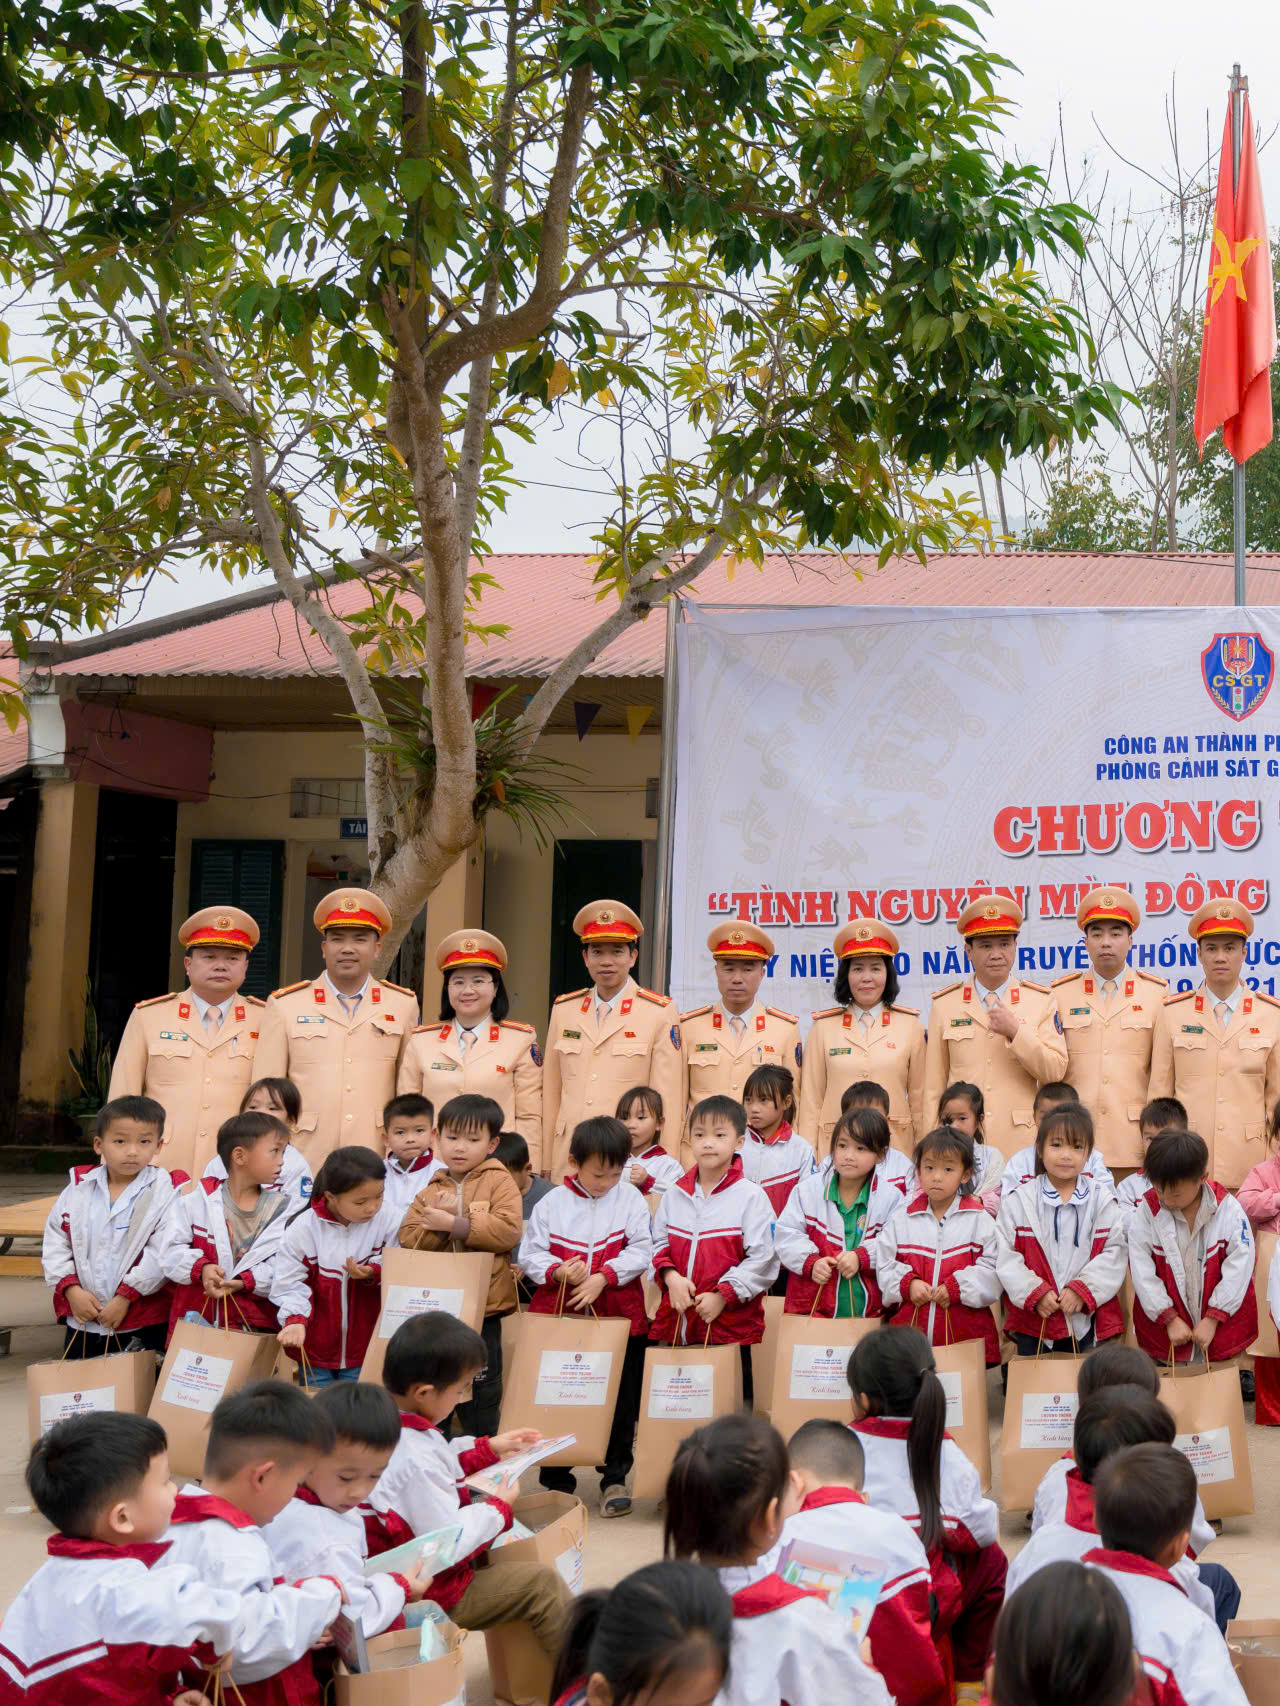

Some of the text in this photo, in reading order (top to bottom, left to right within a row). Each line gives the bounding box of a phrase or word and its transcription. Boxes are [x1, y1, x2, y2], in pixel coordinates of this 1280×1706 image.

[1212, 674, 1265, 687] CSGT
[1104, 735, 1157, 755] CÔNG
[1163, 736, 1189, 754] AN
[1195, 731, 1257, 753] THÀNH
[1096, 761, 1161, 781] PHÒNG
[1168, 756, 1219, 779] CẢNH
[1225, 757, 1260, 778] SÁT
[993, 798, 1259, 852] CHƯƠNG
[790, 948, 836, 983] NIỆ
[1126, 934, 1197, 968] THỐN
